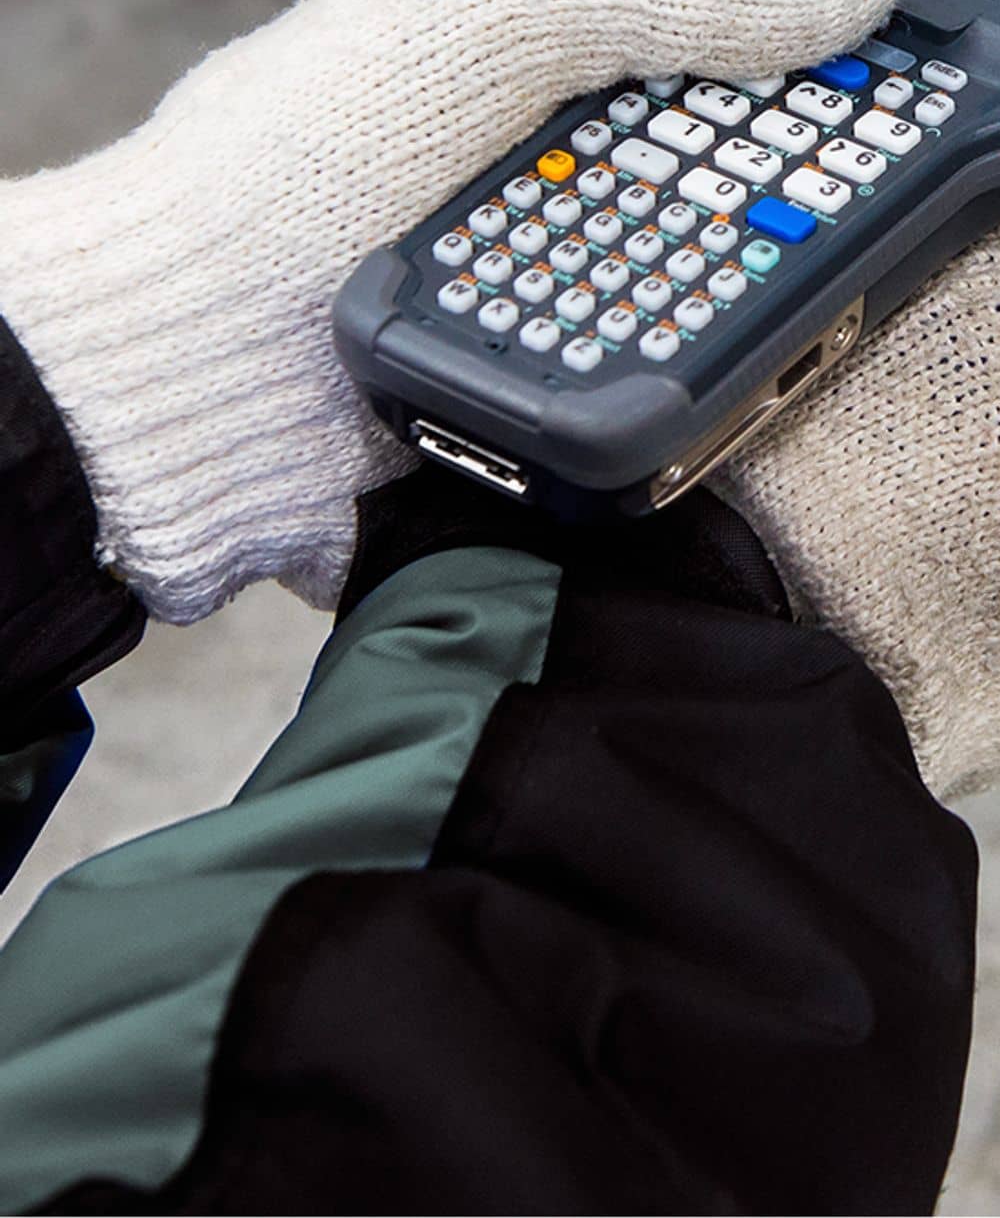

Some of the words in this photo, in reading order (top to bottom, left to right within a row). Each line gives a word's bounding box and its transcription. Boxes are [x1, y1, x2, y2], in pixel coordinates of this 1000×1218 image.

[616, 96, 638, 108] F4
[719, 95, 739, 107] 4
[821, 94, 843, 109] 8
[684, 122, 700, 136] 1
[787, 122, 809, 136] 5
[890, 123, 911, 136] 9
[749, 151, 772, 166] 2
[855, 152, 877, 166] 6
[586, 170, 603, 181] A
[514, 179, 533, 191] E
[716, 181, 736, 195] 0
[819, 182, 841, 196] 3
[629, 188, 647, 199] B
[555, 197, 573, 206] F
[480, 206, 498, 219] K
[669, 206, 687, 217] C
[595, 215, 612, 226] G
[520, 224, 532, 236] L
[710, 224, 728, 235] D
[443, 235, 461, 249] Q
[634, 233, 654, 245] H
[557, 242, 580, 256] M
[484, 254, 502, 266] R
[600, 261, 620, 273] N
[526, 272, 543, 284] S
[719, 272, 736, 282] J
[449, 282, 471, 296] W
[569, 291, 585, 302] T
[489, 302, 508, 314] X
[686, 300, 704, 310] P
[610, 310, 628, 323] U
[534, 321, 550, 332] Y
[653, 329, 670, 341] V
[574, 341, 593, 352] Z
